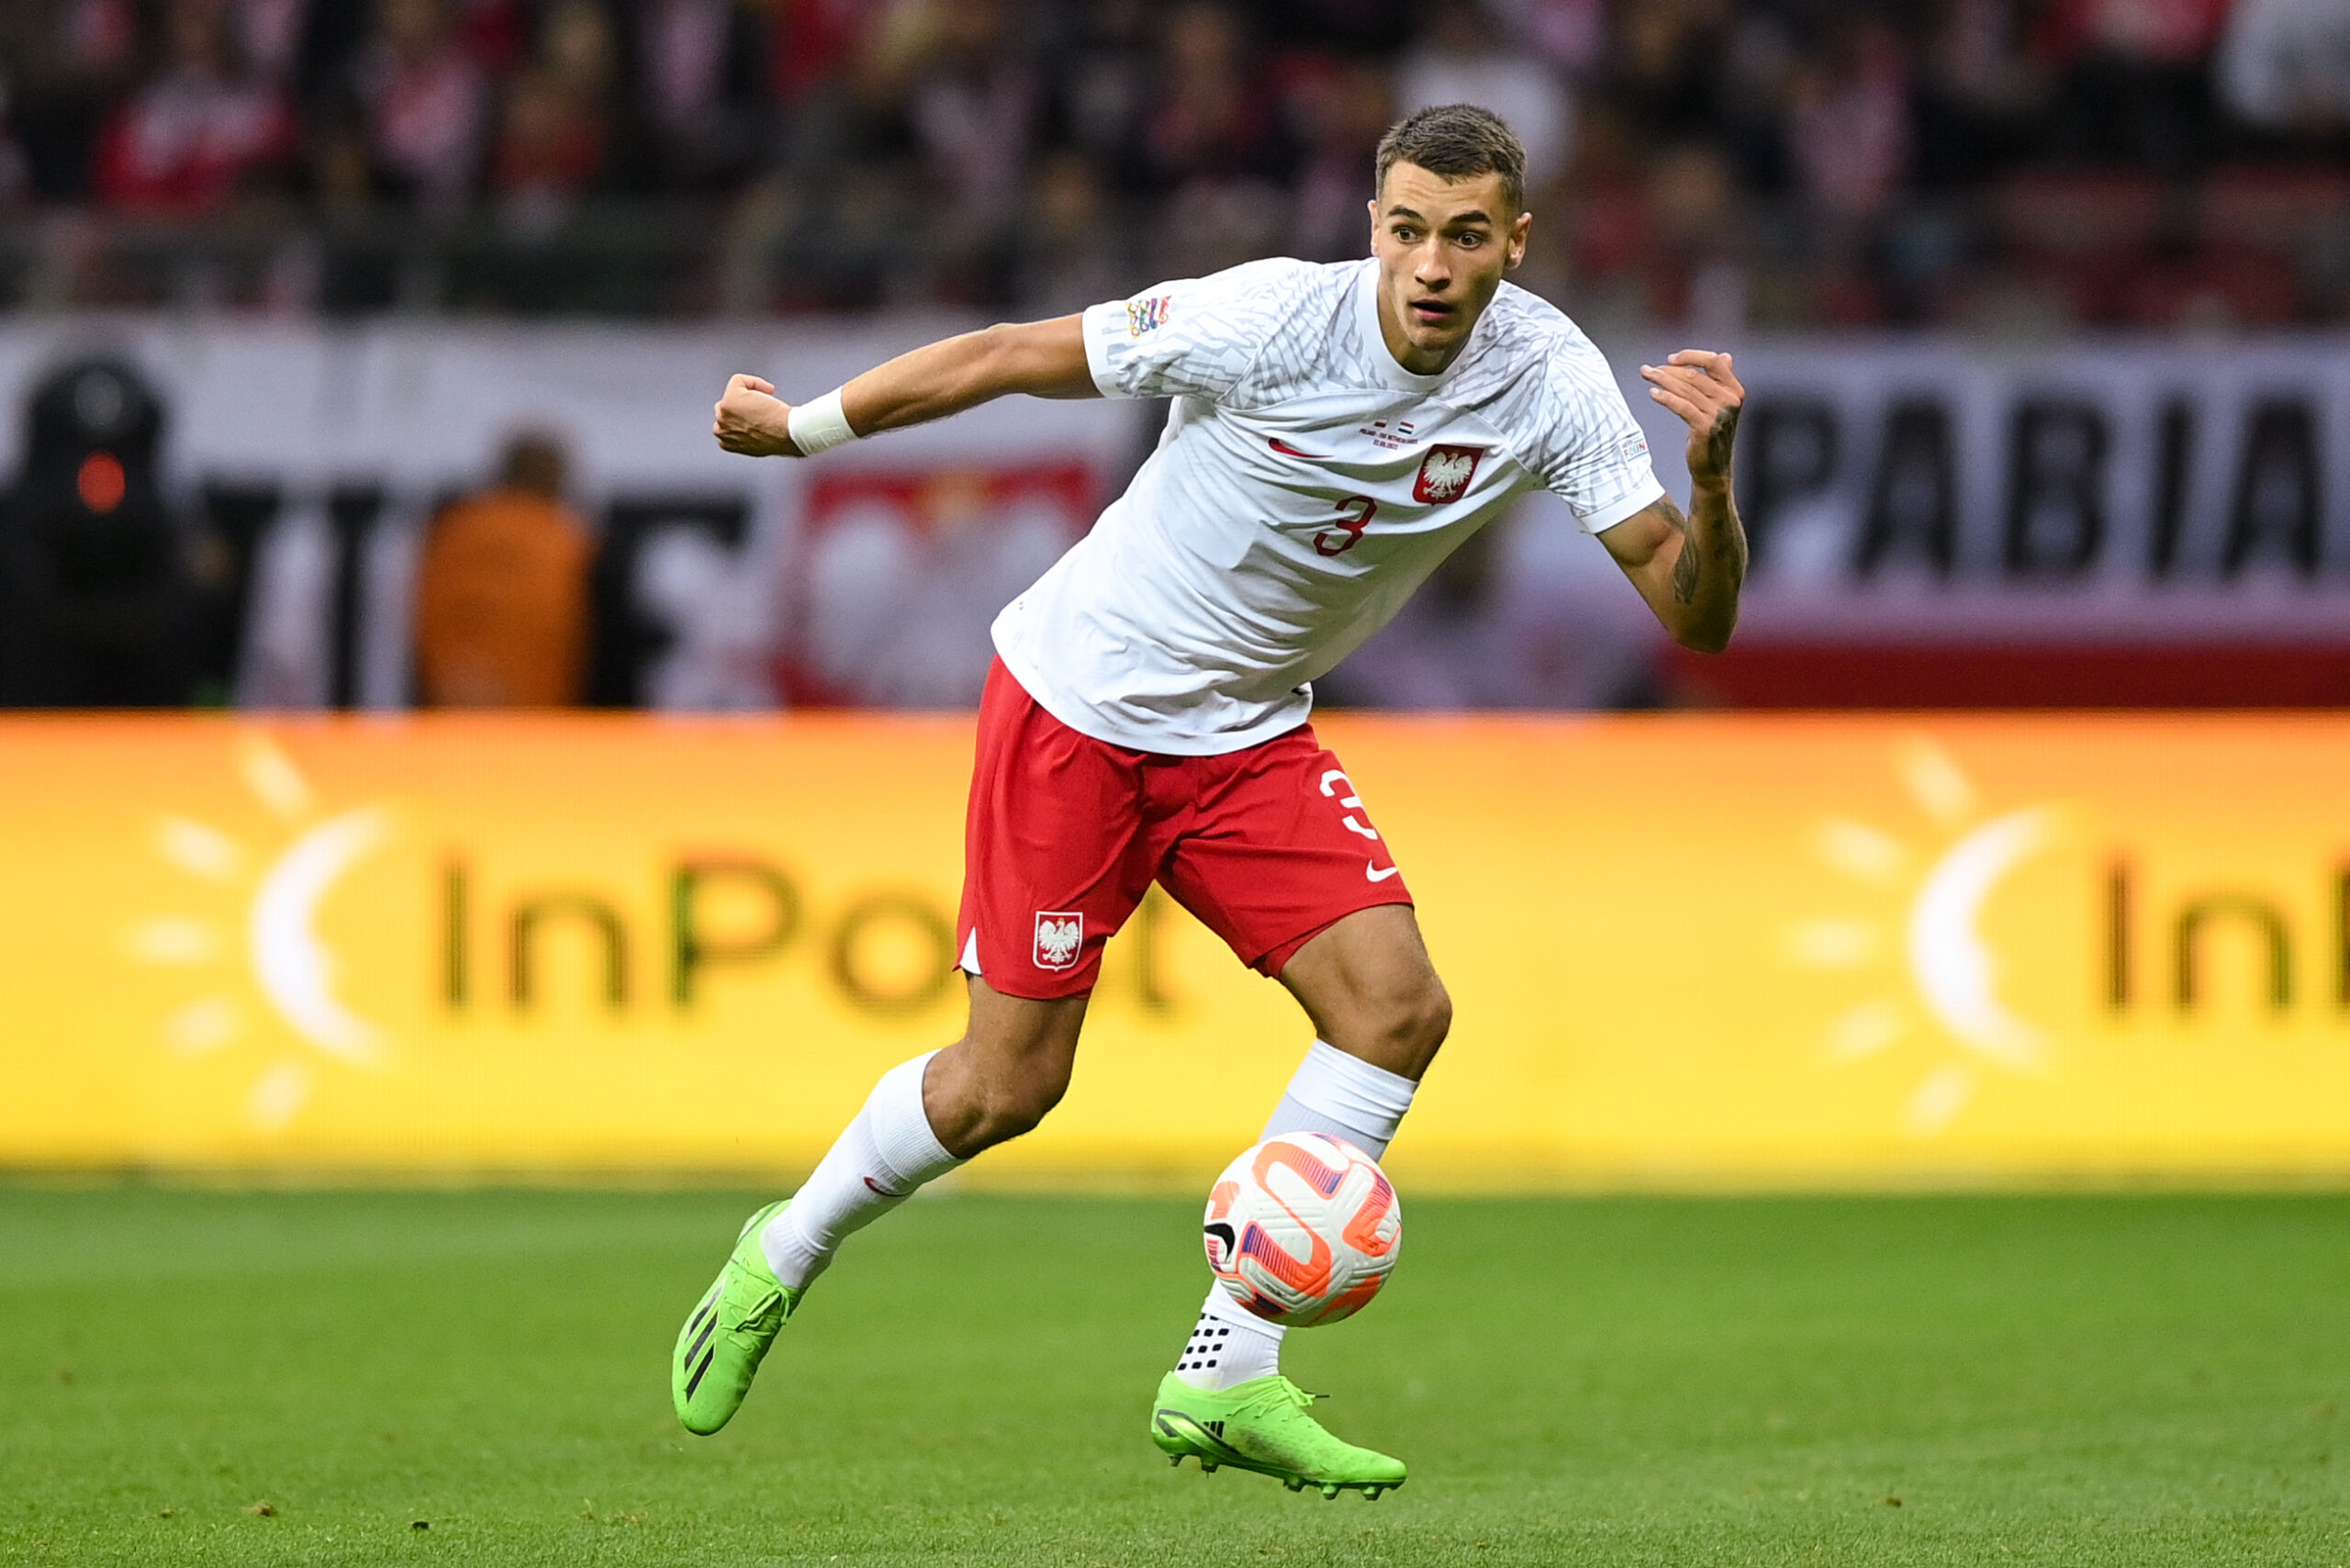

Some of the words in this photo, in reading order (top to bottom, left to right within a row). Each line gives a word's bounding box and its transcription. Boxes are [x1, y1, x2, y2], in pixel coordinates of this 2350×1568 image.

[1314, 495, 1377, 556] 3
[1742, 391, 2324, 584] PABIA
[1320, 769, 1379, 840] 3
[439, 852, 1179, 1019] InPot
[2106, 854, 2350, 1017] In
